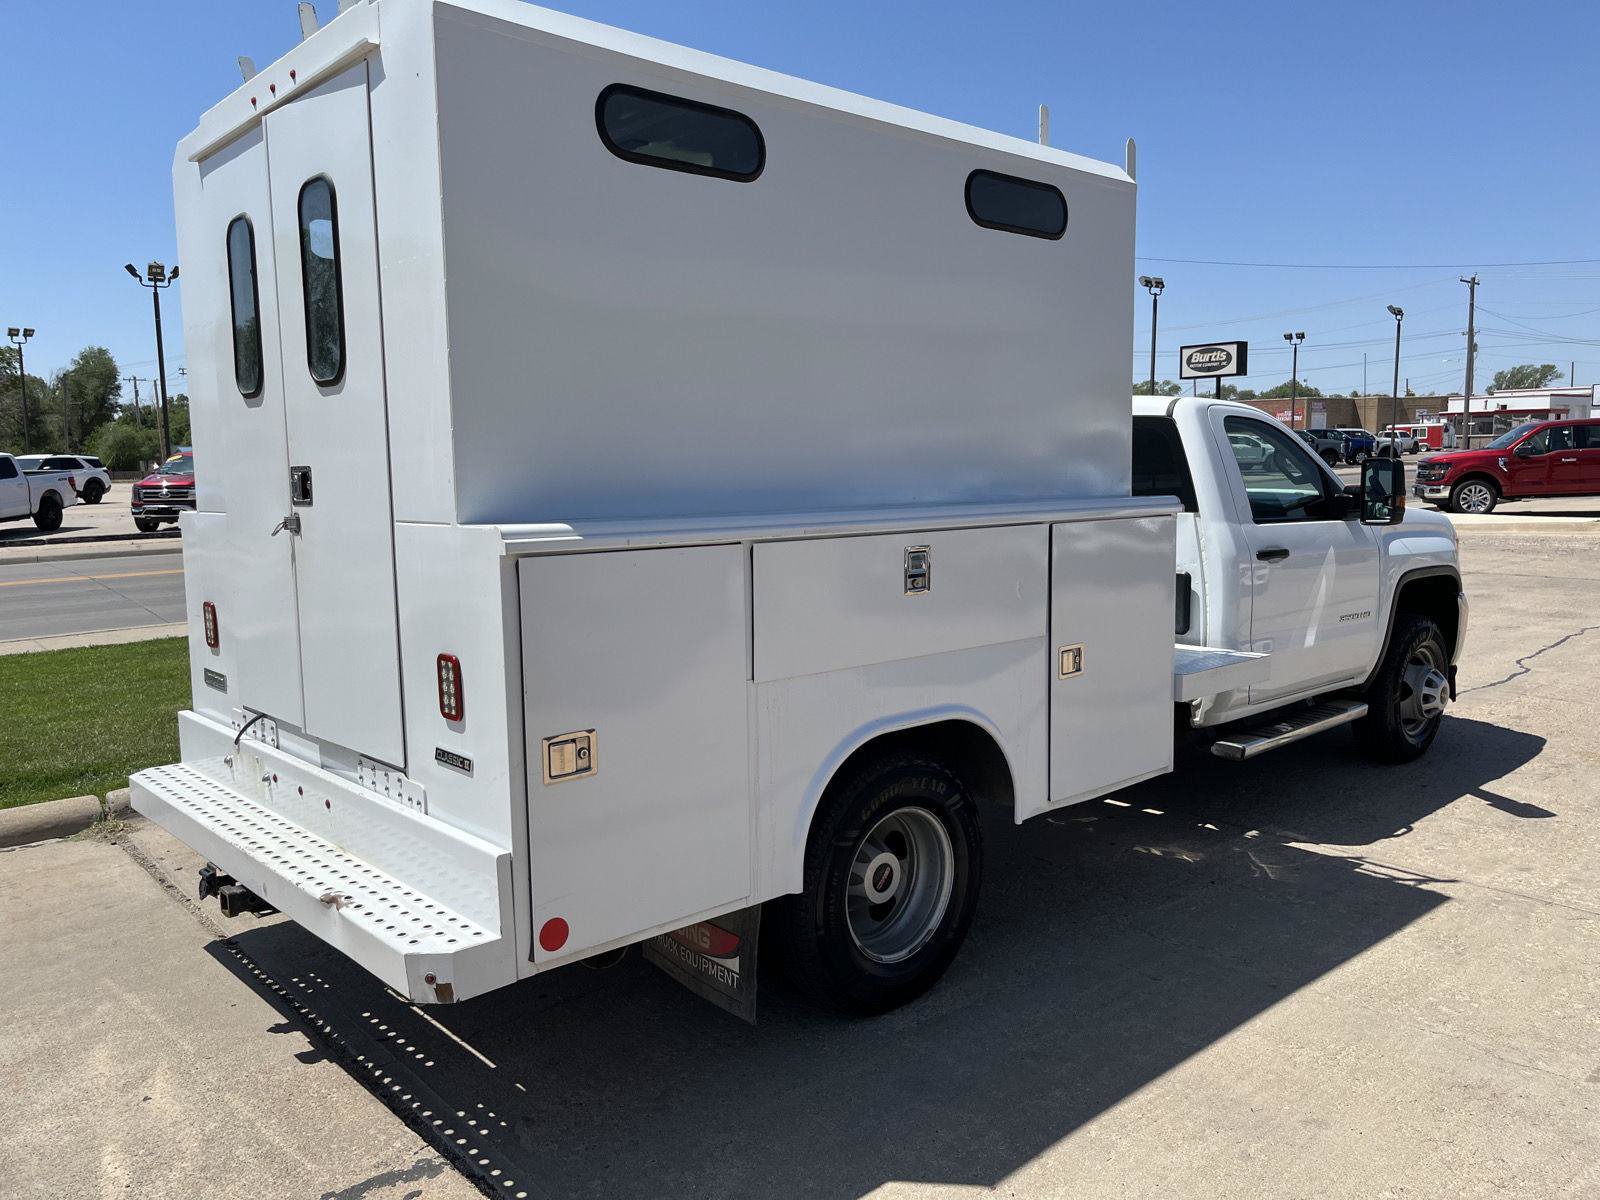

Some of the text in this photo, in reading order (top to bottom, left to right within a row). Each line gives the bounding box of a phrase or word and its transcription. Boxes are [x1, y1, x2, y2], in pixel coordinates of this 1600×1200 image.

[1191, 351, 1227, 363] Burtis
[437, 750, 463, 768] CLASSIC
[680, 946, 739, 989] EQUIPMENT
